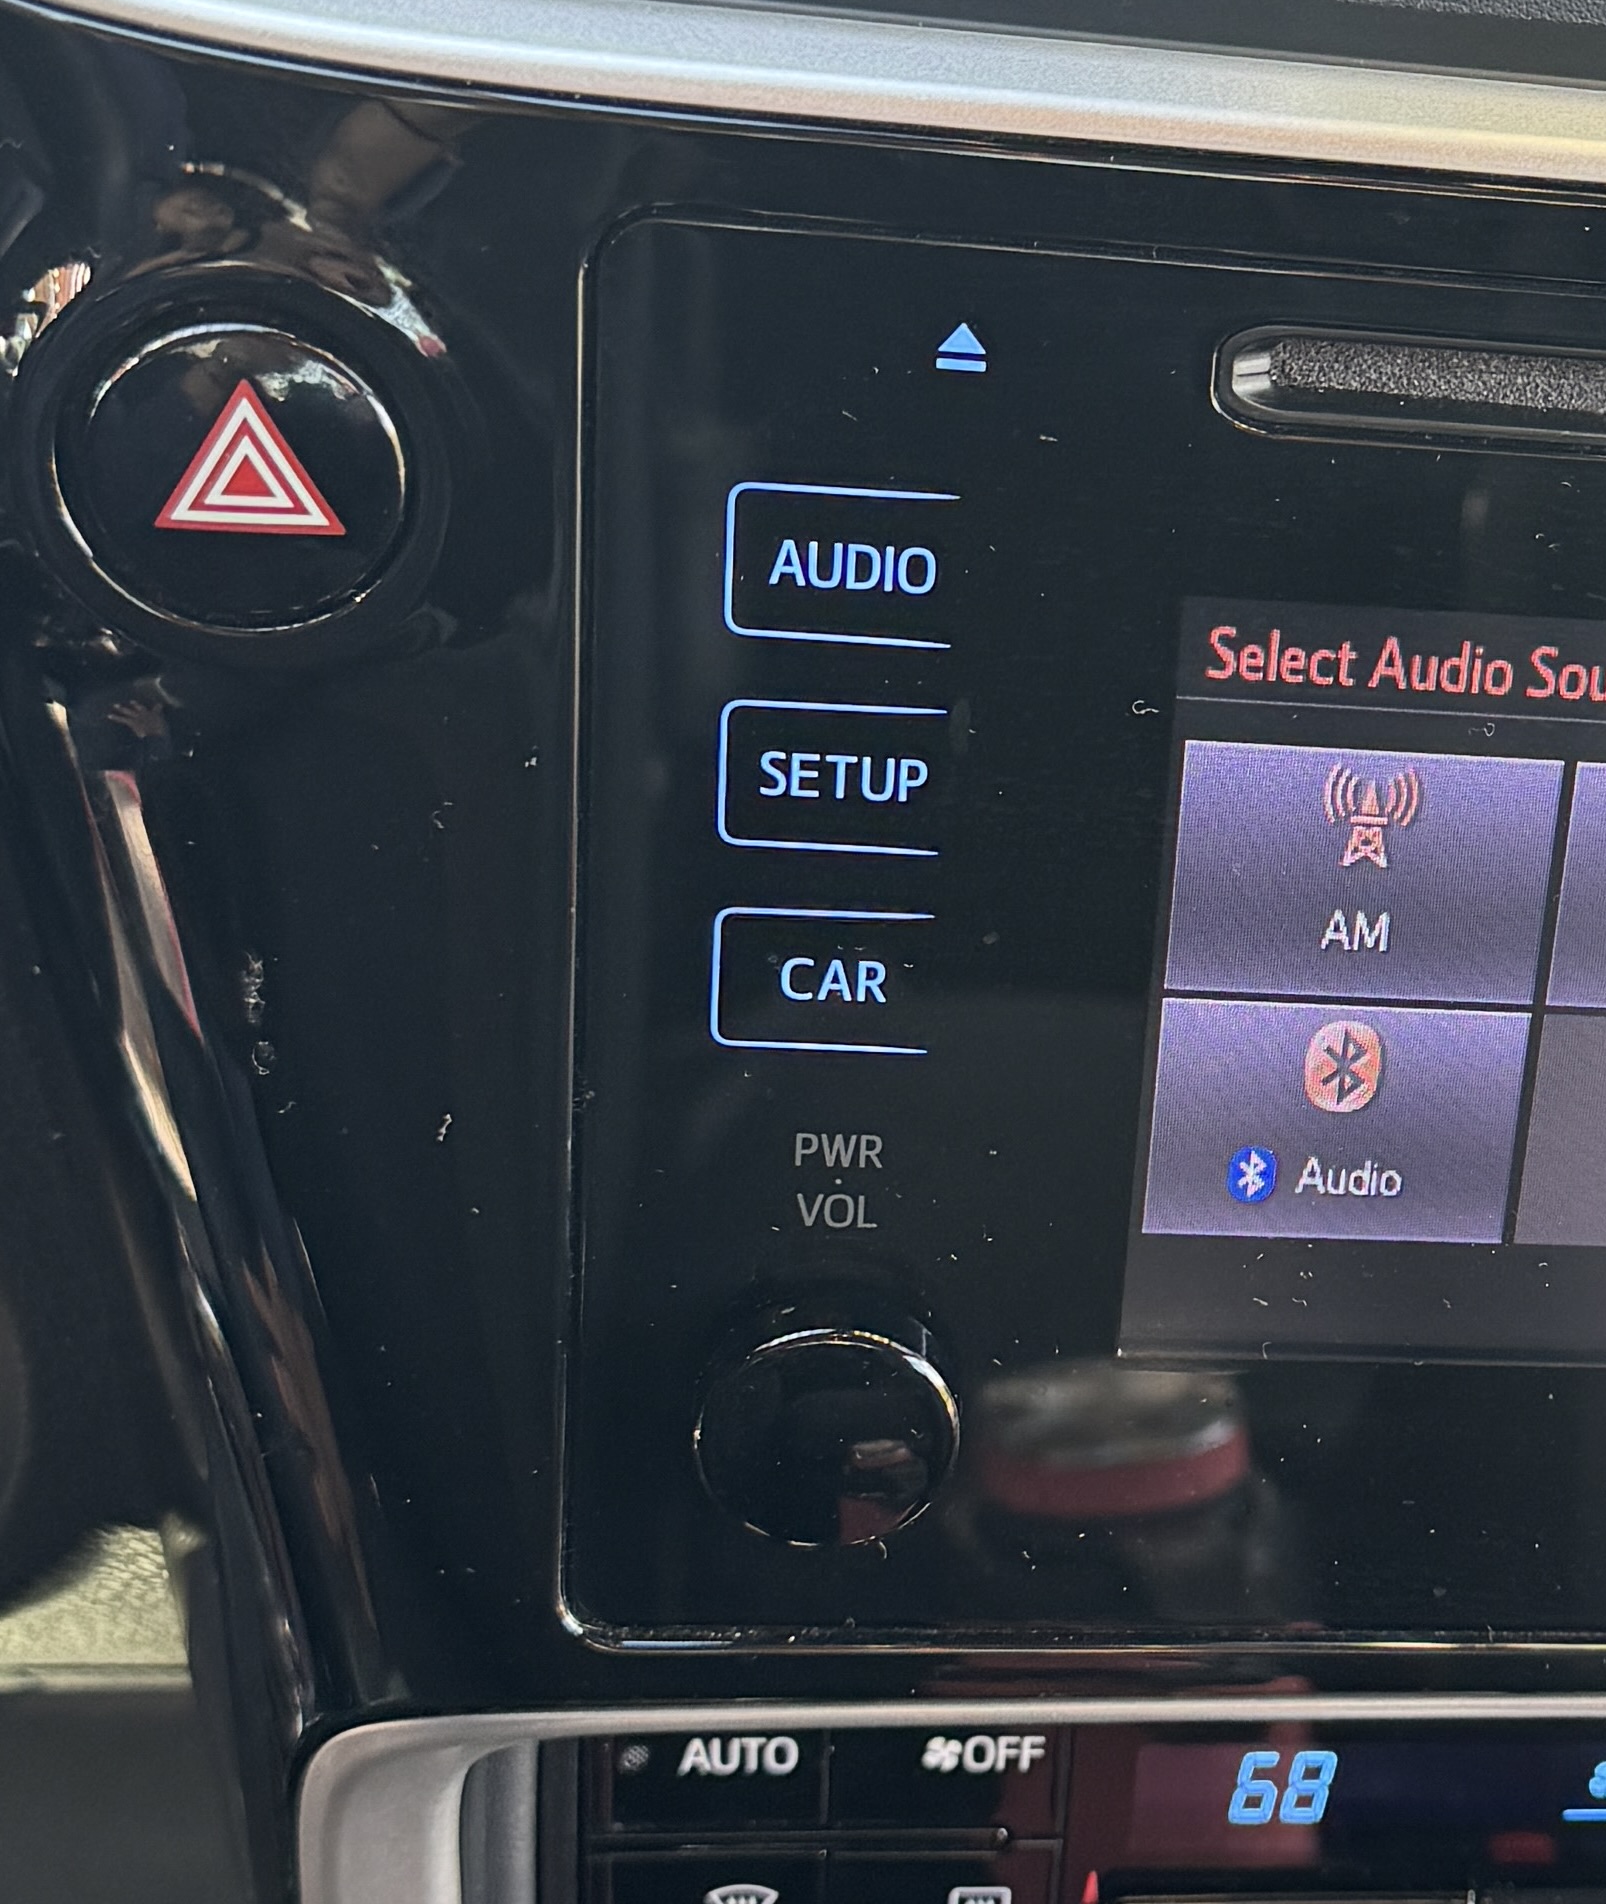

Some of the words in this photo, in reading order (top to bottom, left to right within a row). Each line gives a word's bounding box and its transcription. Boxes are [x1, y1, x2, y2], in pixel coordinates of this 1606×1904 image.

[768, 539, 937, 595] AUDIO
[1206, 625, 1357, 687] Select
[1367, 637, 1514, 696] Audio
[759, 750, 928, 803] SETUP
[1320, 909, 1390, 952] AM
[780, 957, 886, 1003] CAR
[794, 1132, 883, 1169] PWR
[1294, 1156, 1402, 1196] Audio
[796, 1192, 878, 1229] VOL
[679, 1736, 799, 1774] AUTO
[963, 1735, 1046, 1772] OFF
[1227, 1750, 1338, 1825] 68
